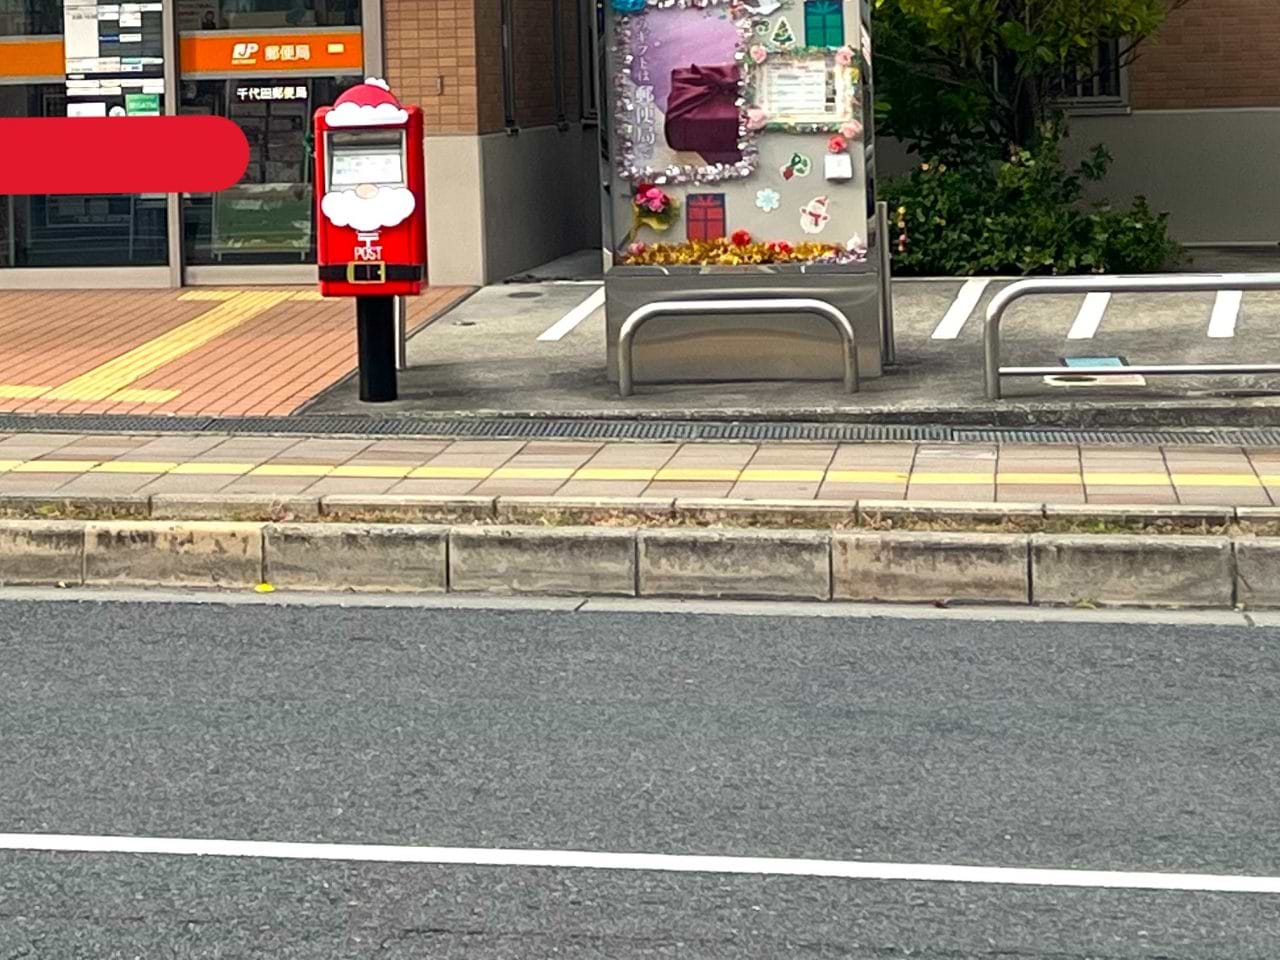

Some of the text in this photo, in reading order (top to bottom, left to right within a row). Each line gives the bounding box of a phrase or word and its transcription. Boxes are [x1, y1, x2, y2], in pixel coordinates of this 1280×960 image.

[265, 44, 310, 61] 郵便局
[236, 86, 308, 100] 千代田郵便局
[354, 246, 382, 260] POST
